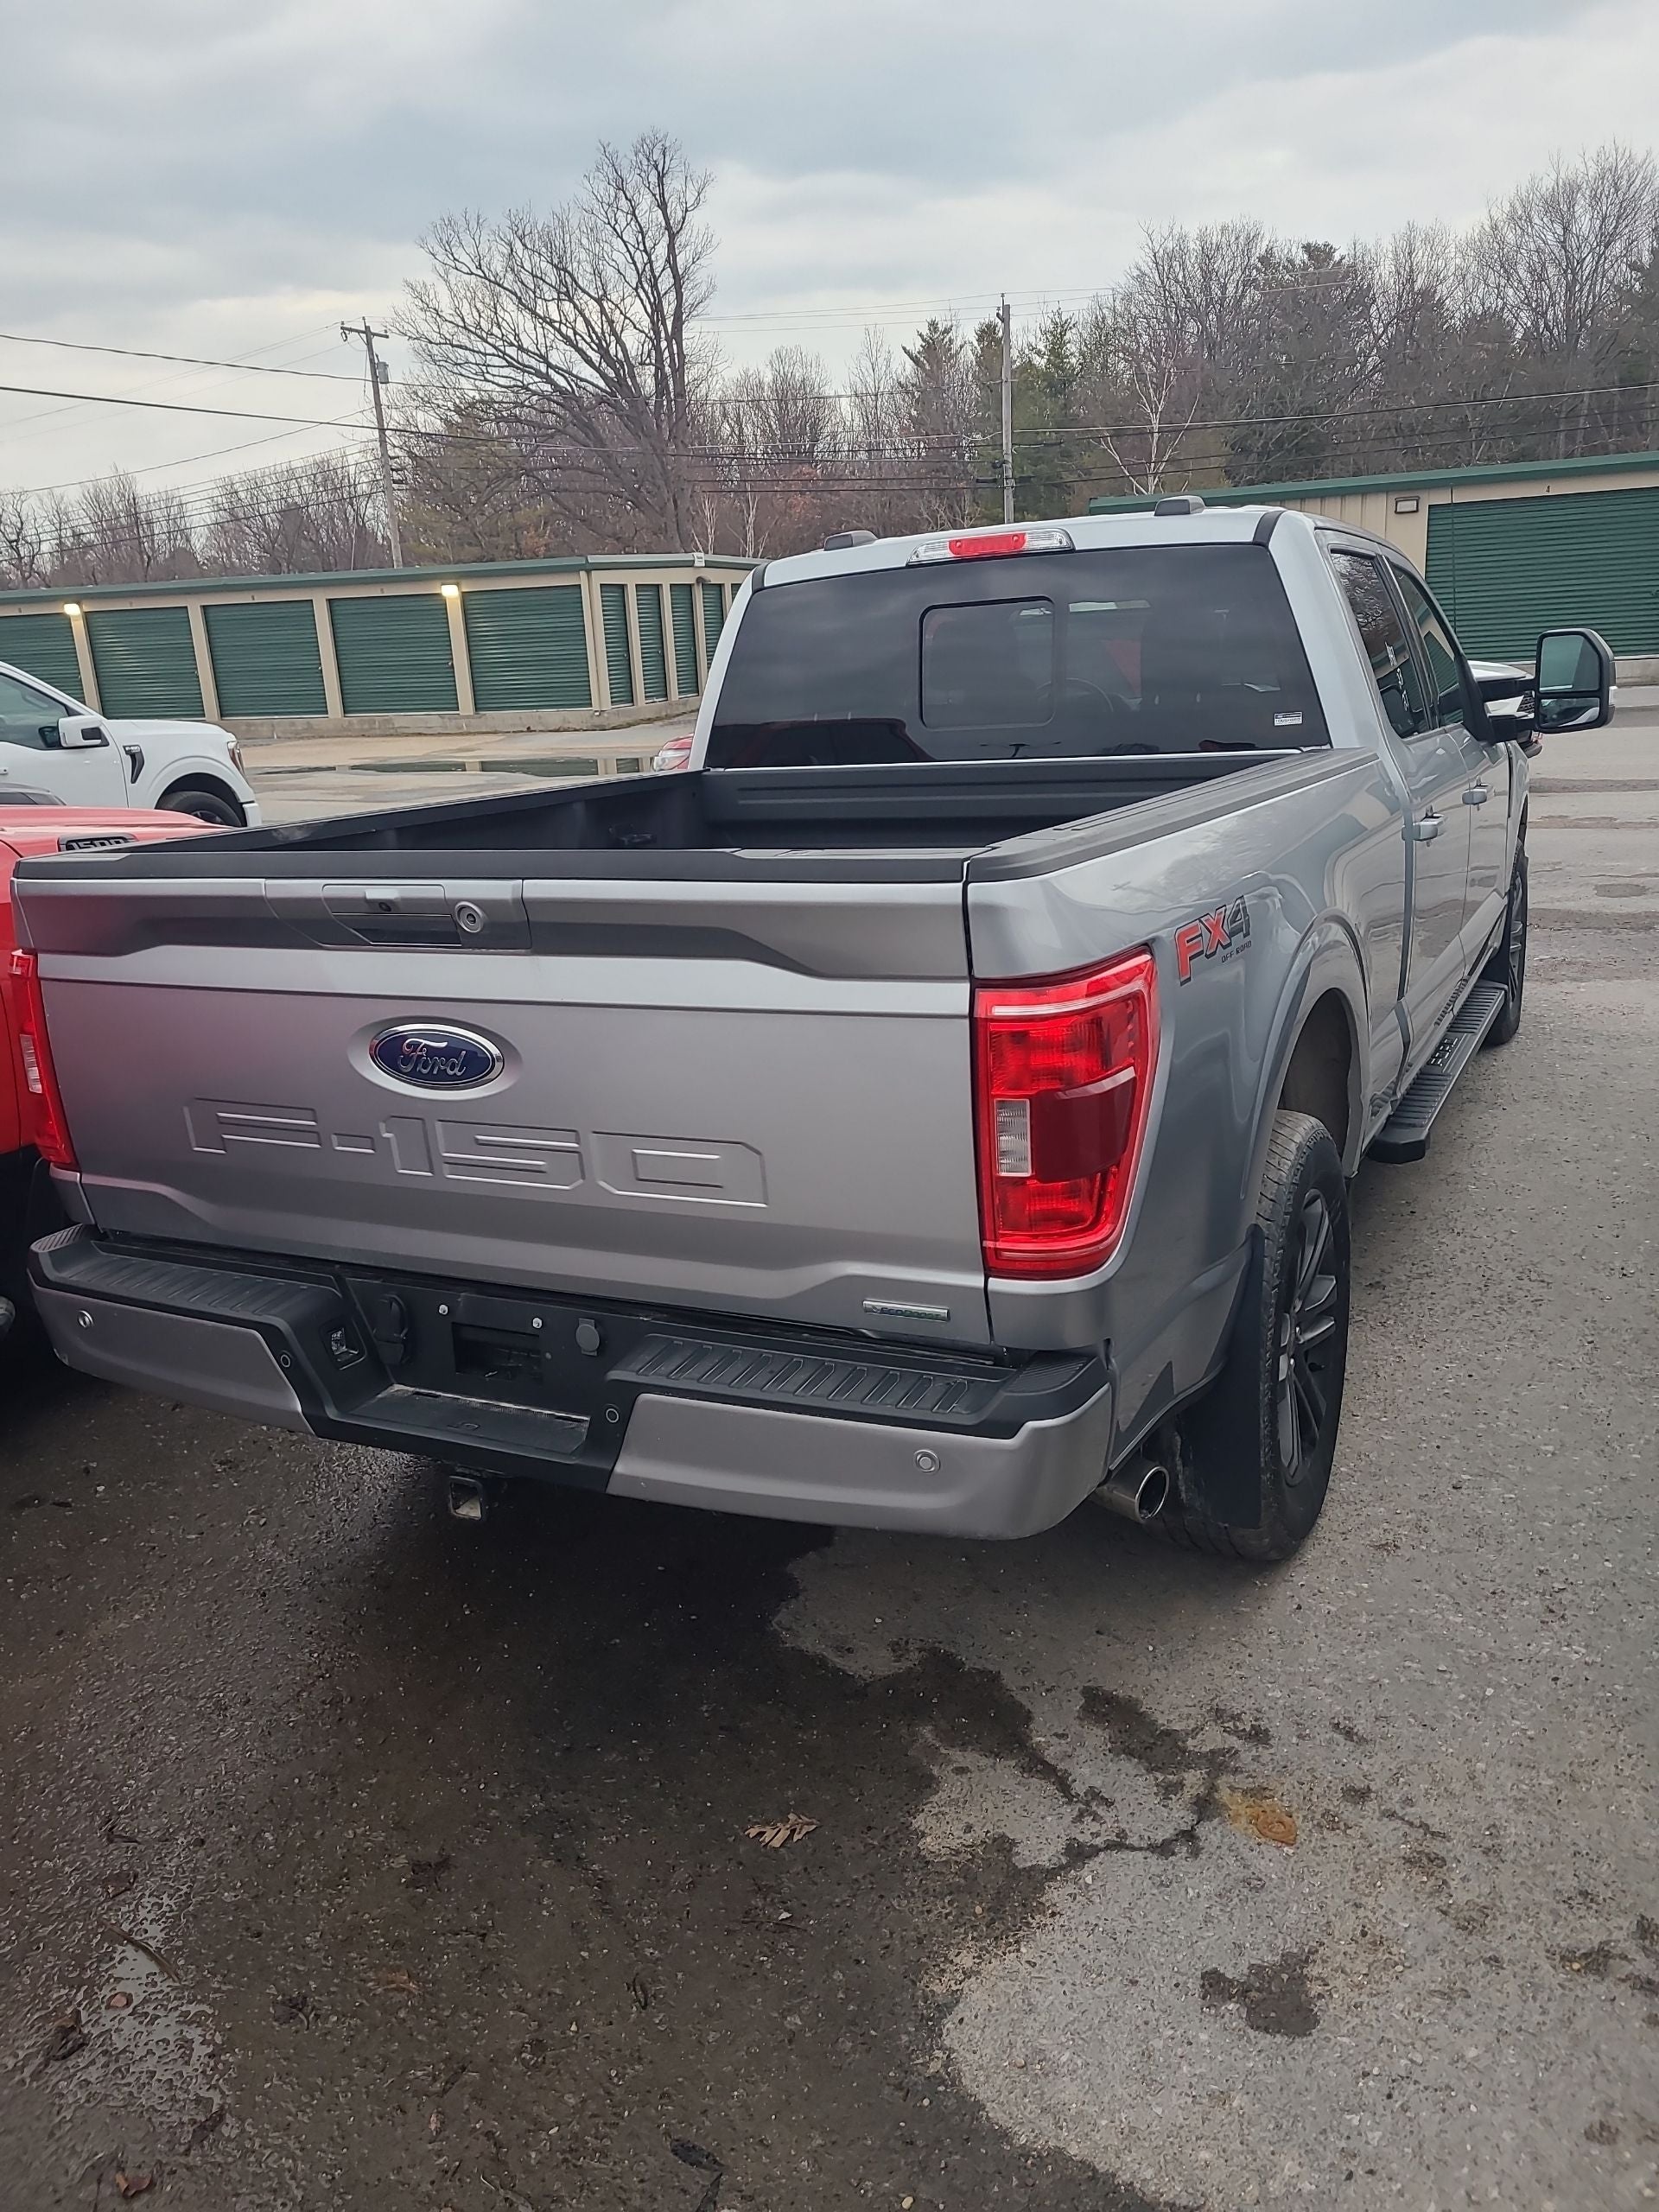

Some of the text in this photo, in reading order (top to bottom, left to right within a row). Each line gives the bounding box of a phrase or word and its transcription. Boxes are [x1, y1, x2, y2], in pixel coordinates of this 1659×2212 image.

[1174, 895, 1250, 986] FX4
[1221, 940, 1252, 963] OFF ROAD
[398, 1038, 467, 1077] Ford
[183, 1097, 768, 1208] F-150
